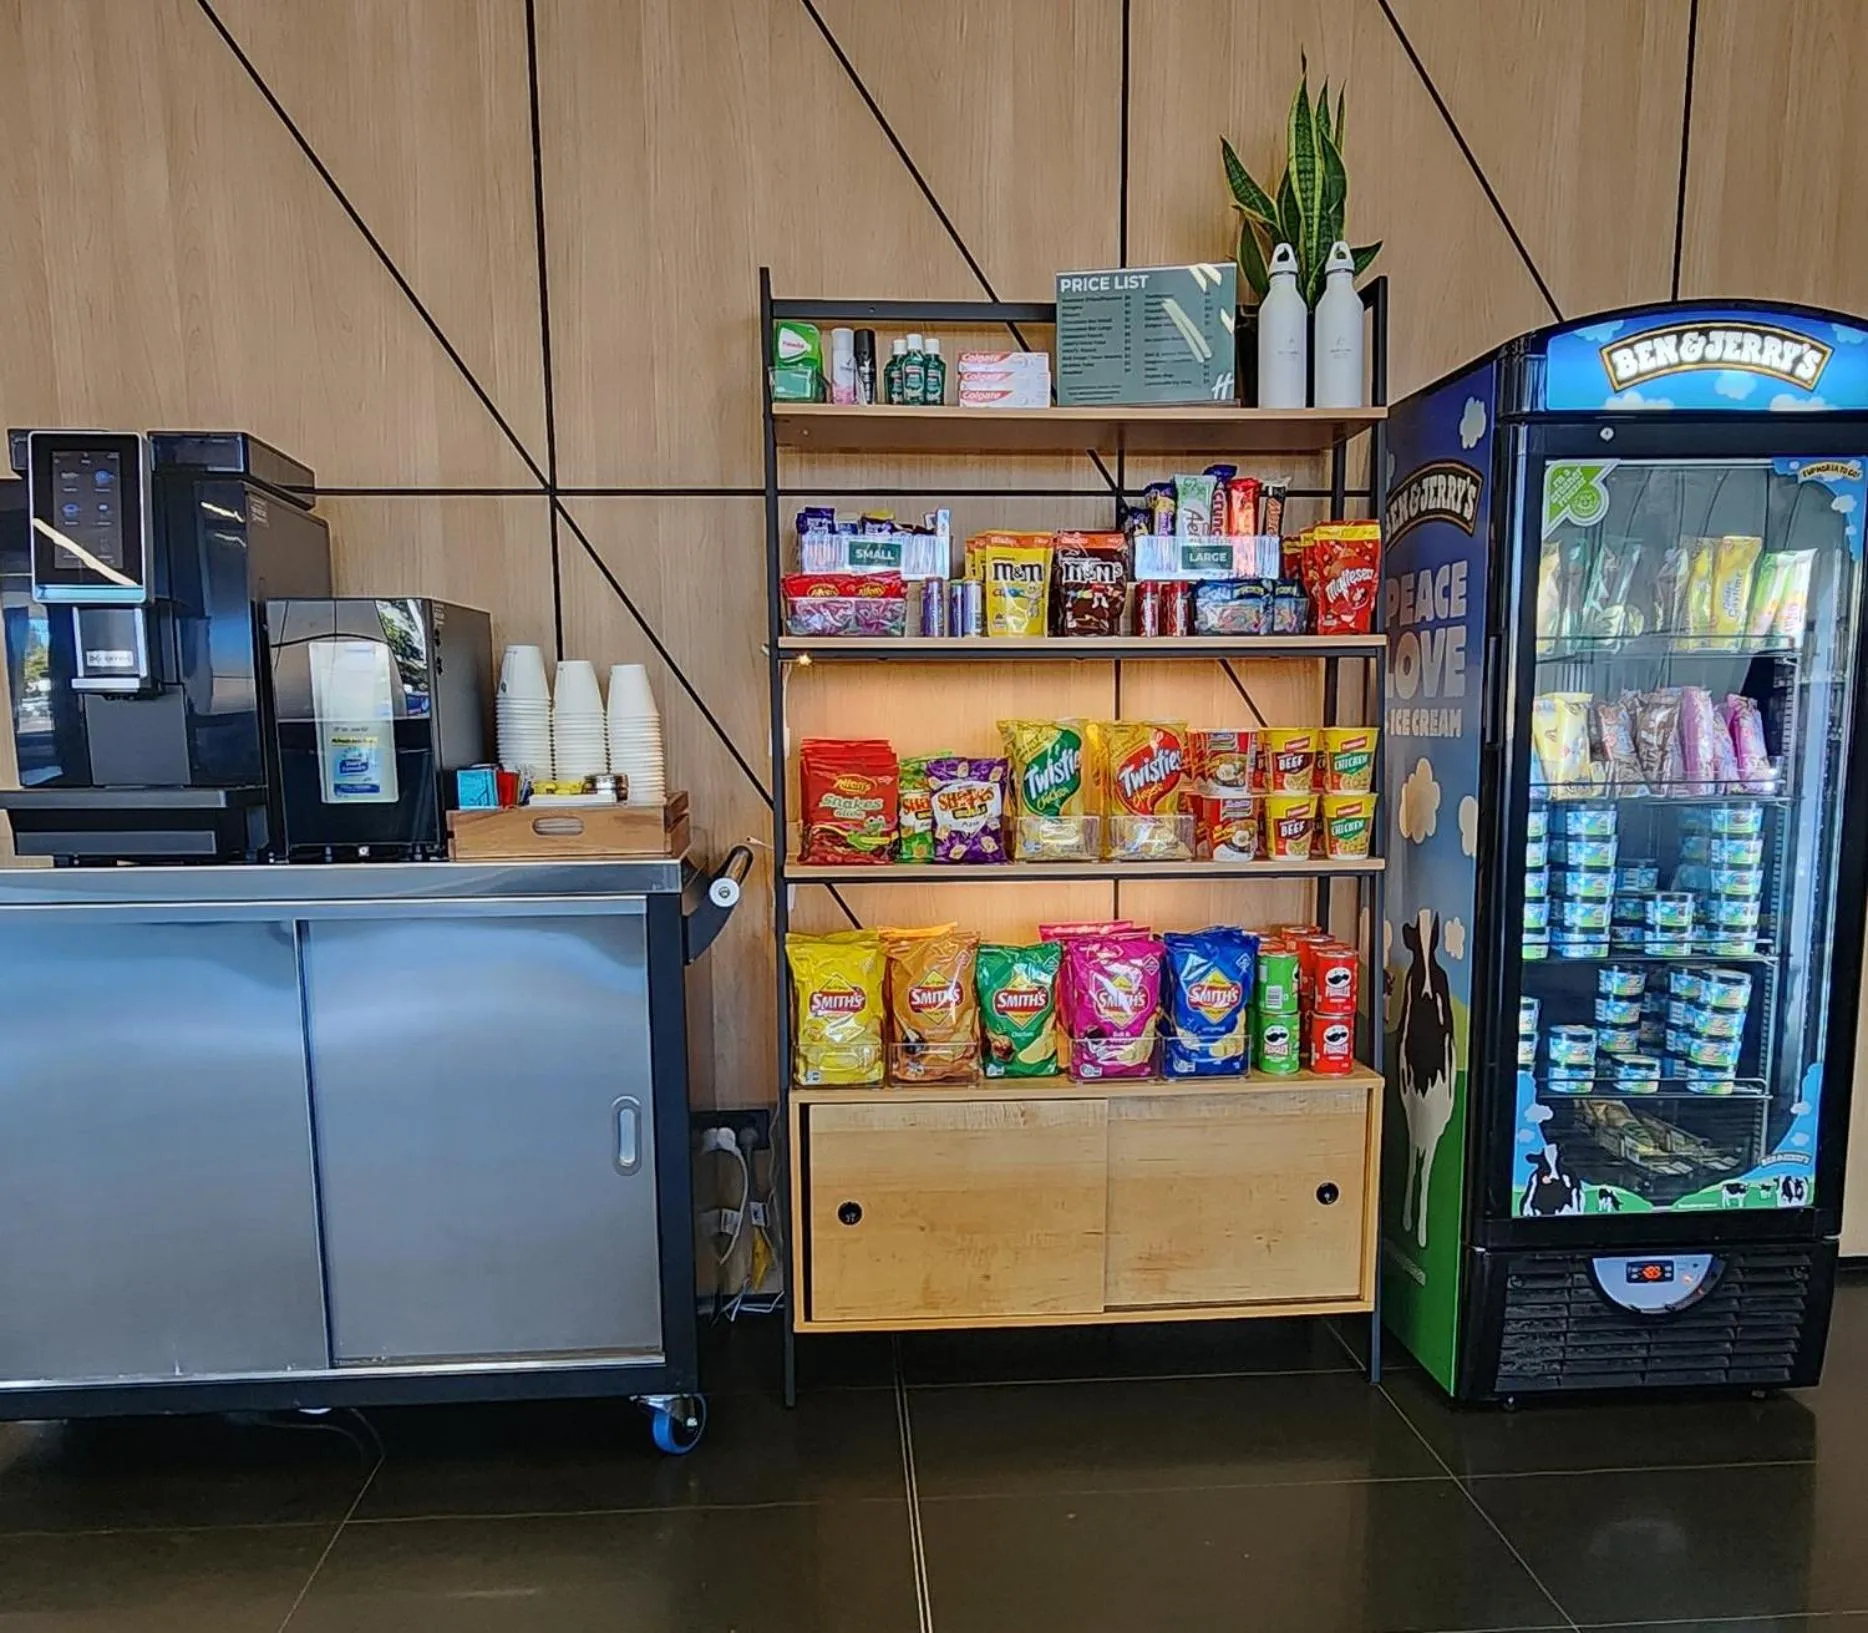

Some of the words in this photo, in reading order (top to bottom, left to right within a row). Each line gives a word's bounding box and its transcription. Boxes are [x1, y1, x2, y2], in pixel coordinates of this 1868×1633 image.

[1060, 276, 1110, 293] PRICE
[1114, 274, 1149, 290] LIST
[855, 548, 895, 560] SMALL
[1188, 552, 1227, 563] LARGE
[1385, 560, 1468, 628] PEACE
[1390, 708, 1411, 737] ICE
[1411, 708, 1462, 738] CREAM
[1279, 754, 1304, 771] BEEF
[1281, 820, 1305, 837] BEEF
[811, 993, 865, 1010] SMITH'S
[997, 990, 1047, 1009] SMITH'S
[1189, 986, 1239, 1004] SMITH'S
